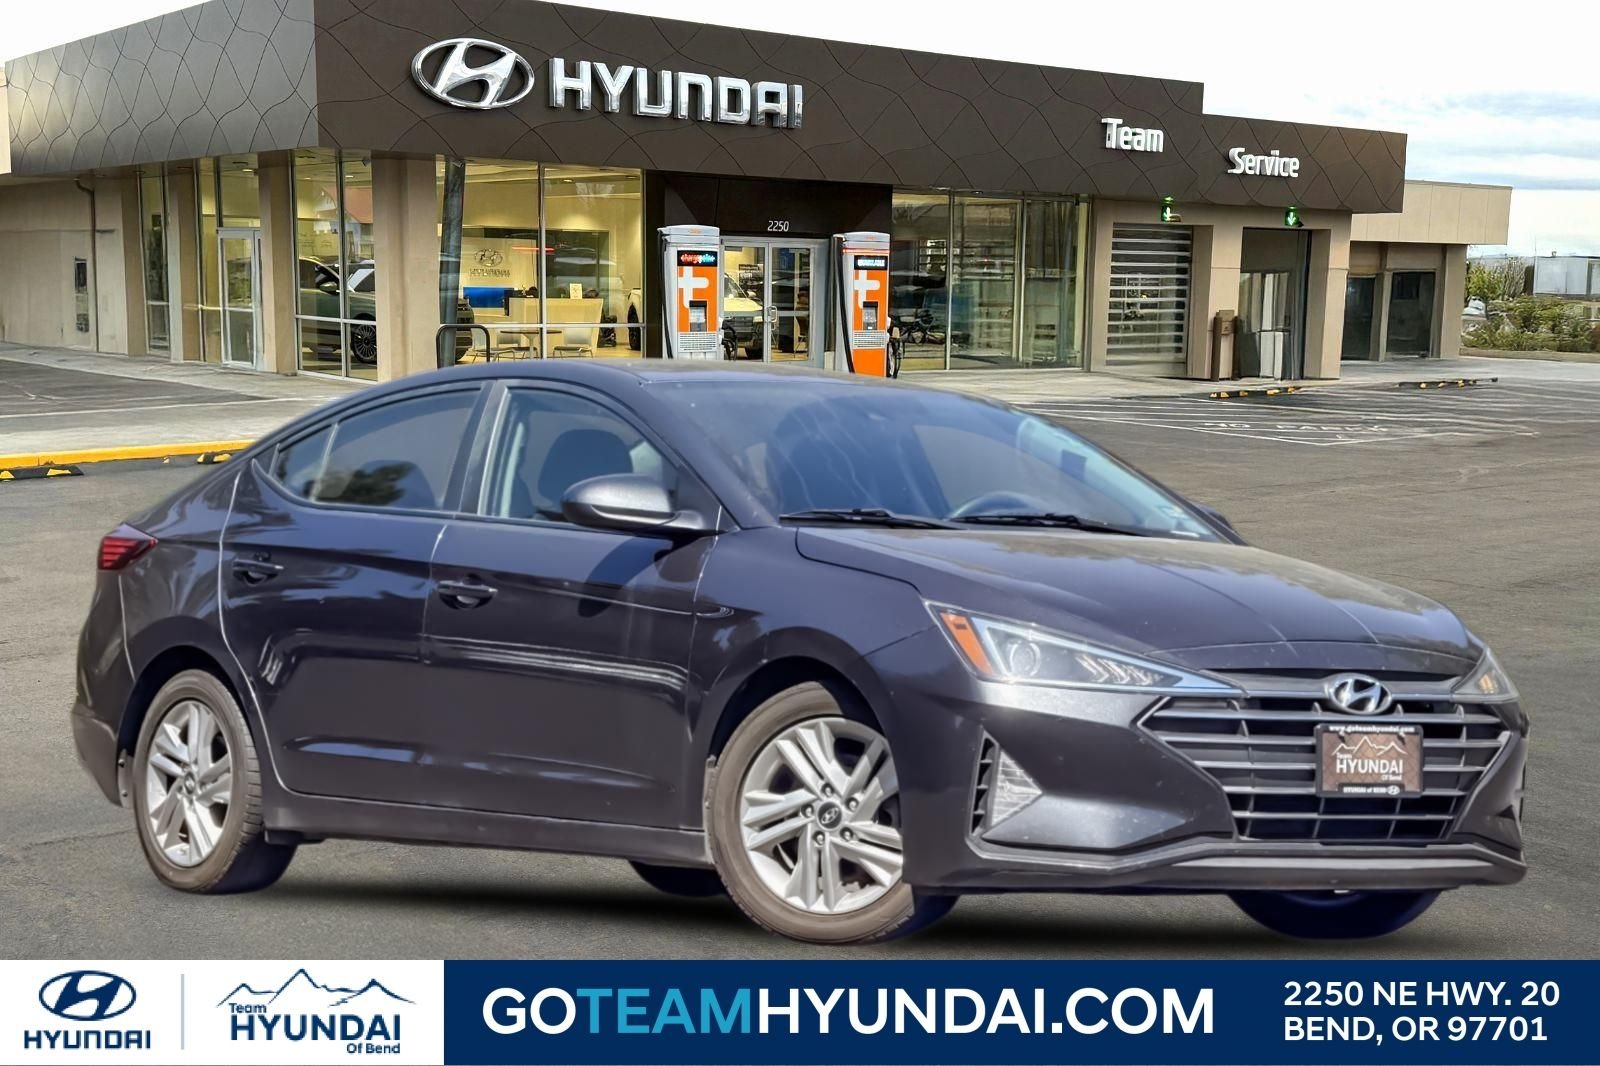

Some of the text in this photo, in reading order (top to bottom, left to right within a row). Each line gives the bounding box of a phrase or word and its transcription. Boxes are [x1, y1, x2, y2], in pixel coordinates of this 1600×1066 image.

[549, 57, 804, 129] HYUNDAI
[1101, 117, 1164, 153] Team
[1227, 147, 1300, 178] Service
[767, 220, 790, 232] 2250
[1336, 759, 1404, 774] HYUNDAI
